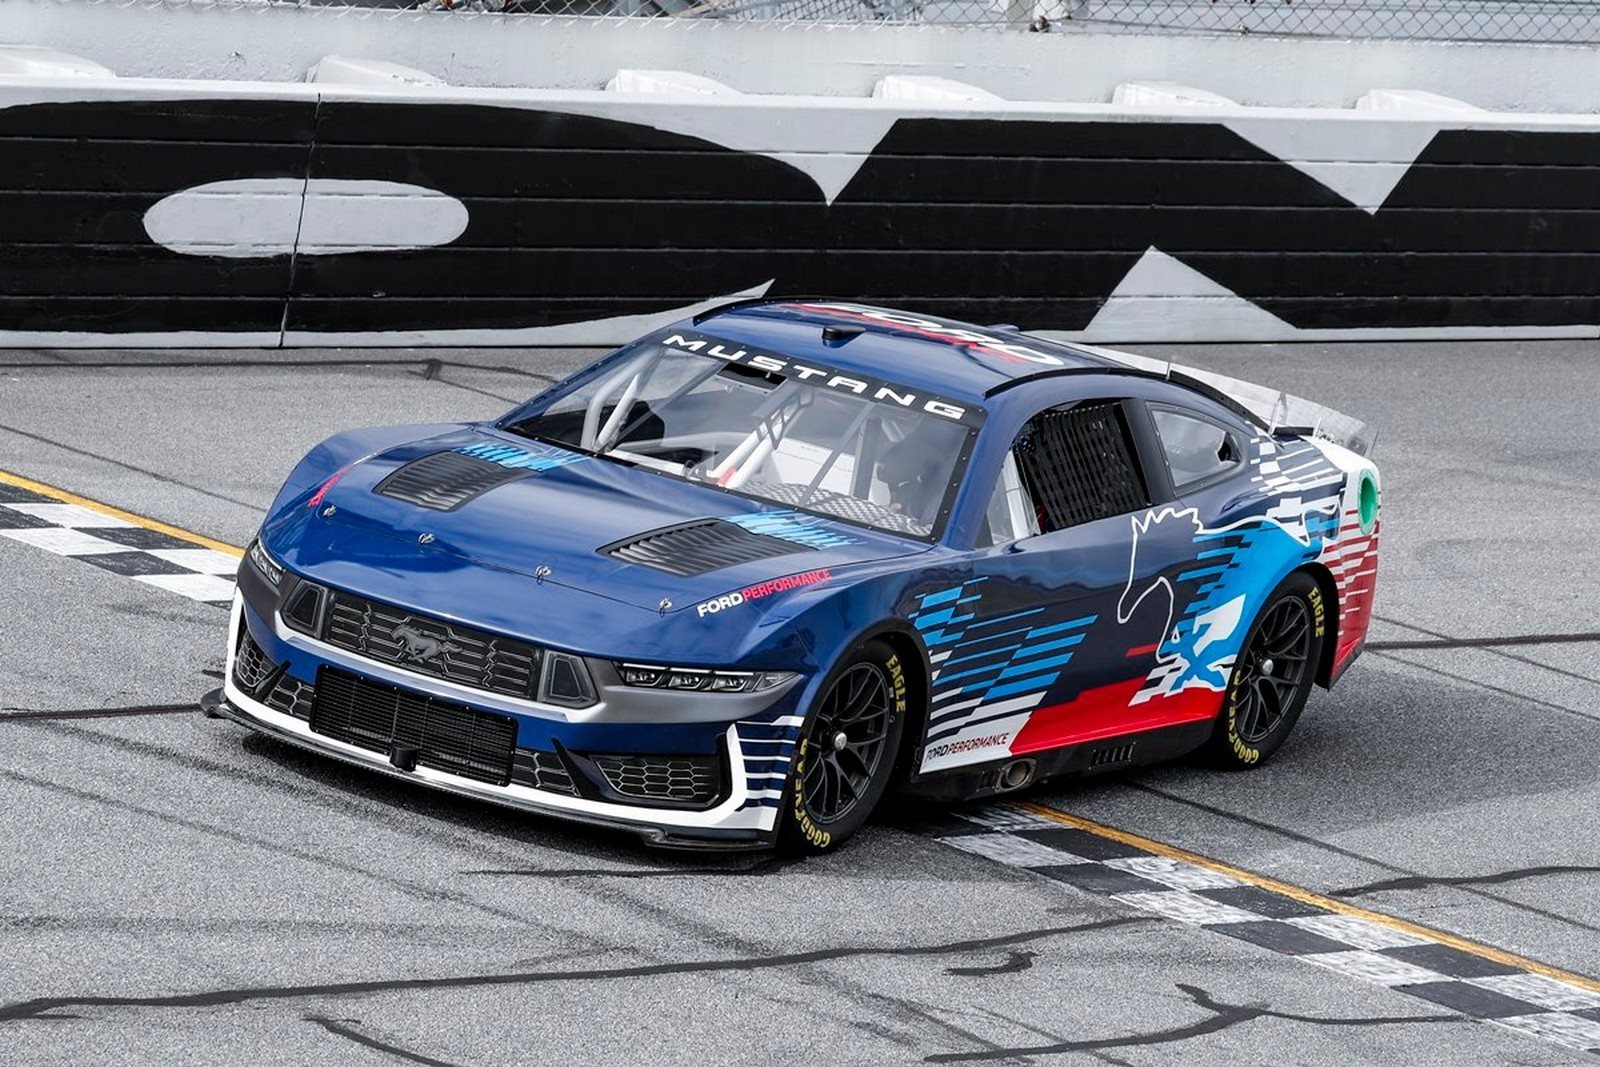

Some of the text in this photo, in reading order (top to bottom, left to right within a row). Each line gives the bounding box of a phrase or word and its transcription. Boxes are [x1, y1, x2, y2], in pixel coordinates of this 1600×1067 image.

[662, 333, 968, 420] MUSTANG
[1307, 586, 1325, 638] EAGLE
[885, 654, 906, 713] EAGLE
[795, 738, 832, 848] GOODYEAR
